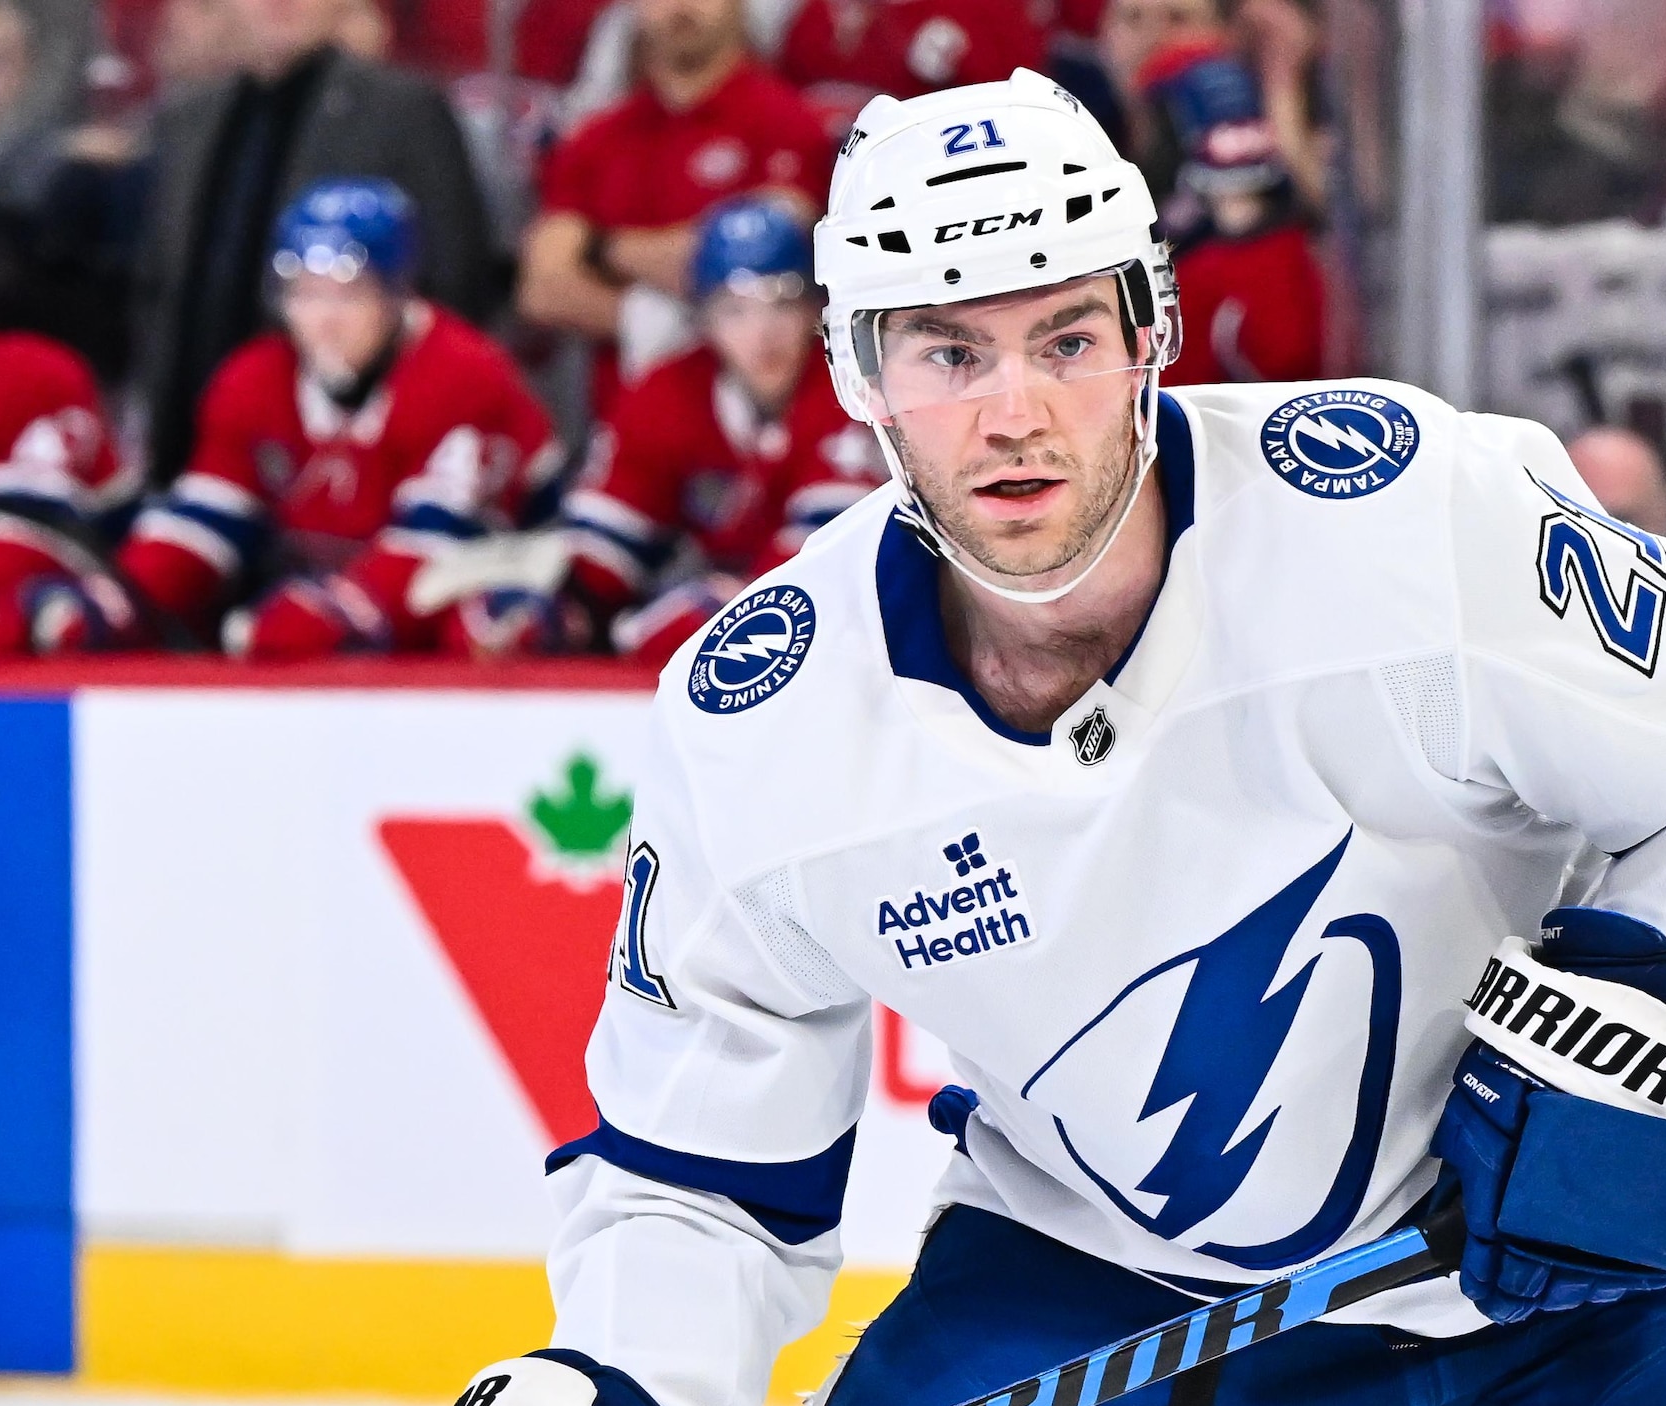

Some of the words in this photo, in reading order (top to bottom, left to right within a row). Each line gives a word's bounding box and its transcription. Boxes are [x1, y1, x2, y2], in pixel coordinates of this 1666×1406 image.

[940, 119, 1005, 157] 21
[934, 208, 1043, 244] CCM
[1267, 391, 1387, 434] LIGHTNING
[1404, 426, 1414, 446] CLUB
[1266, 440, 1299, 474] BAY
[1300, 470, 1385, 494] TAMPA
[710, 590, 776, 637] TAMPA
[779, 590, 809, 616] BAY
[719, 621, 811, 709] LIGHTNING
[1083, 721, 1104, 759] NHL
[878, 868, 1018, 935] Advent
[895, 908, 1031, 969] Health
[1462, 1072, 1501, 1104] COVERT
